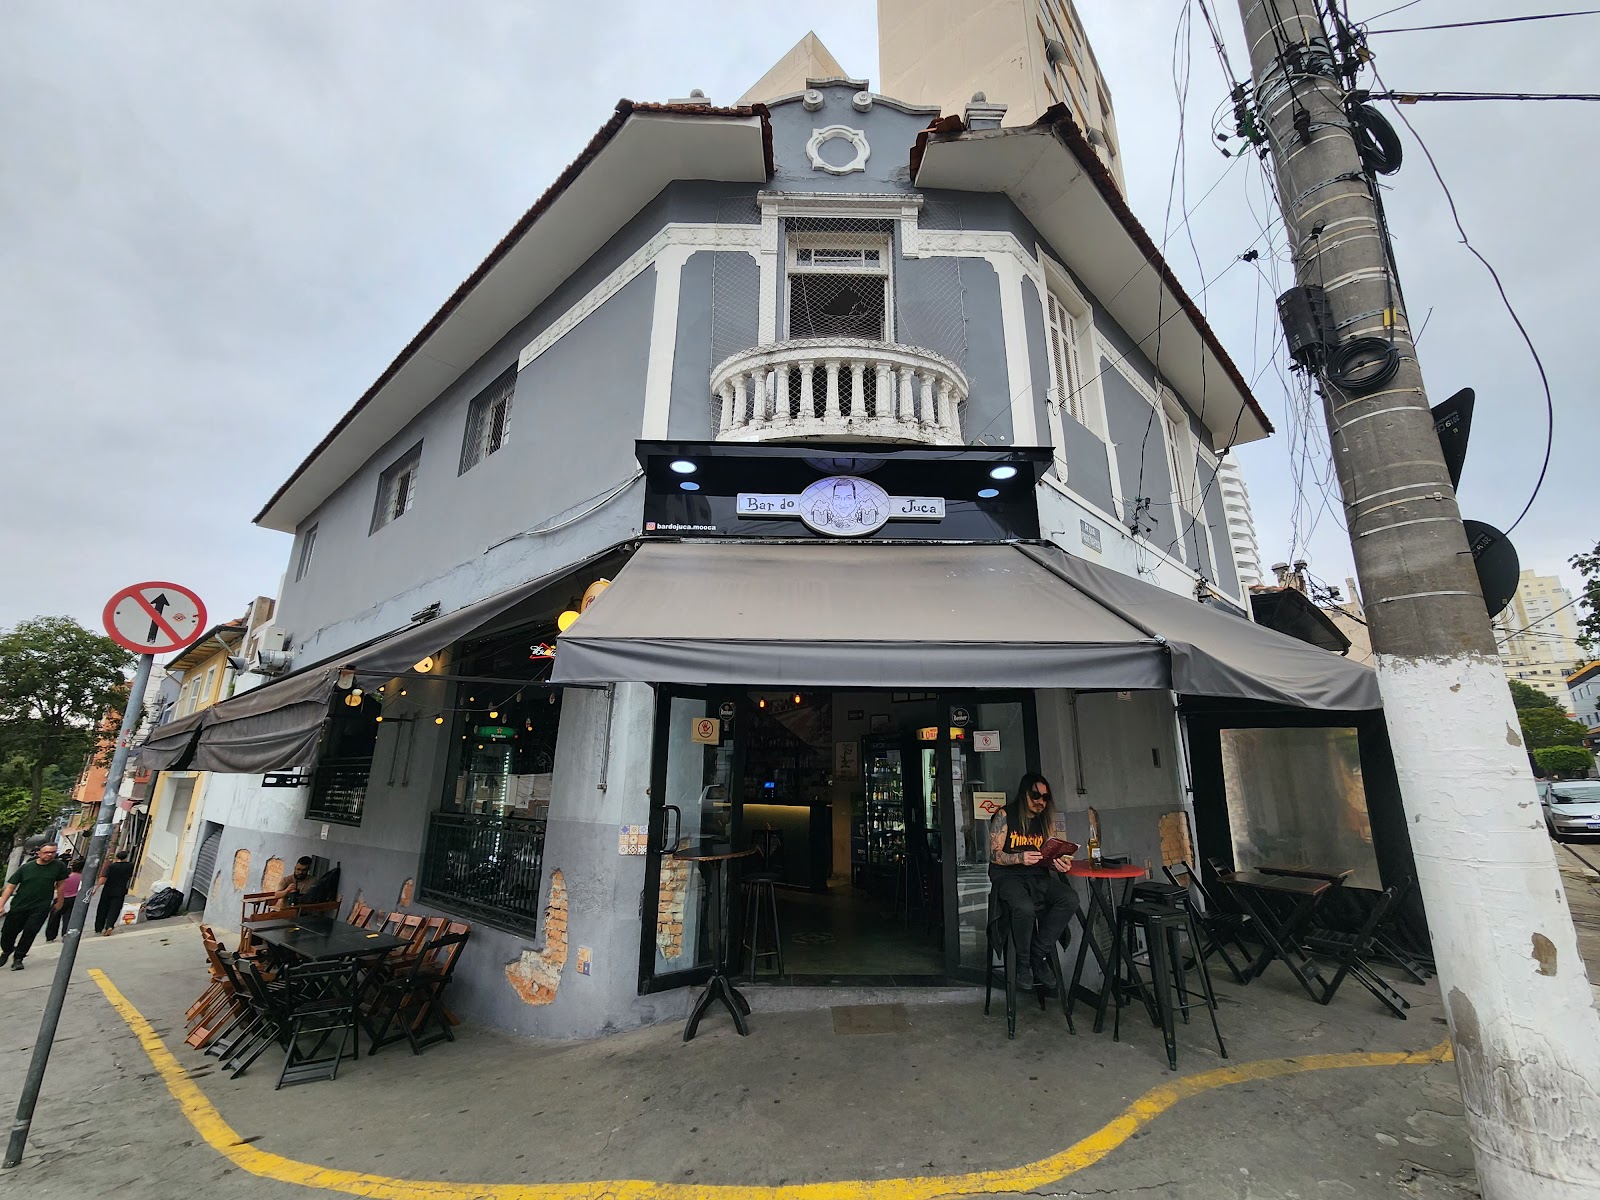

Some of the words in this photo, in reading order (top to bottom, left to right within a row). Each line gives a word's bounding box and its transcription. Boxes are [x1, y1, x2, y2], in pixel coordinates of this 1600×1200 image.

[745, 497, 775, 511] Bar
[780, 498, 795, 510] do
[902, 499, 937, 514] Juca
[656, 523, 717, 531] bardojuca.mooca
[1084, 522, 1096, 537] RUA
